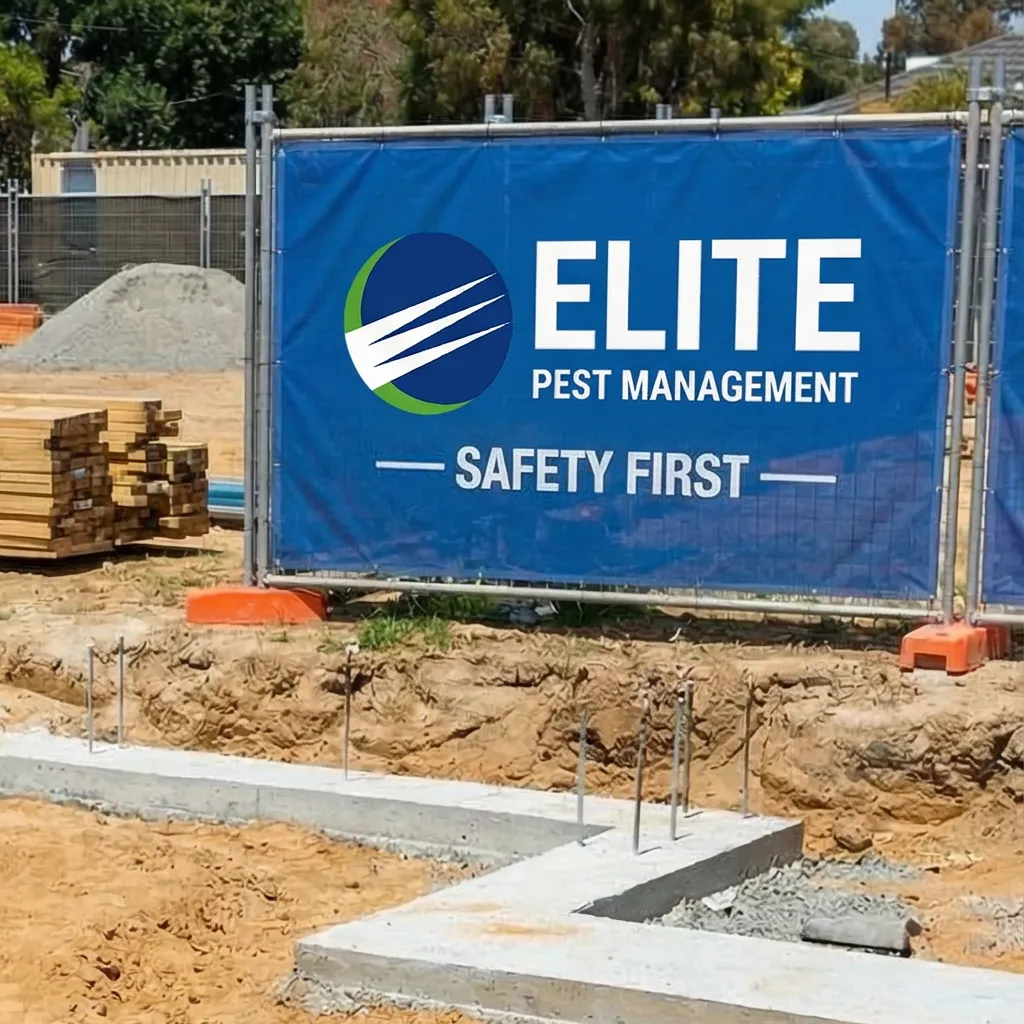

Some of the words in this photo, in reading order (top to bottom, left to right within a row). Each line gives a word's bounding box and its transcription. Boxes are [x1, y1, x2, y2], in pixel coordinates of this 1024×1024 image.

[534, 238, 862, 352] ELITE
[532, 368, 611, 400] PEST
[621, 370, 859, 403] MANAGEMENT
[455, 446, 614, 493] SAFETY
[626, 451, 750, 498] FIRST
